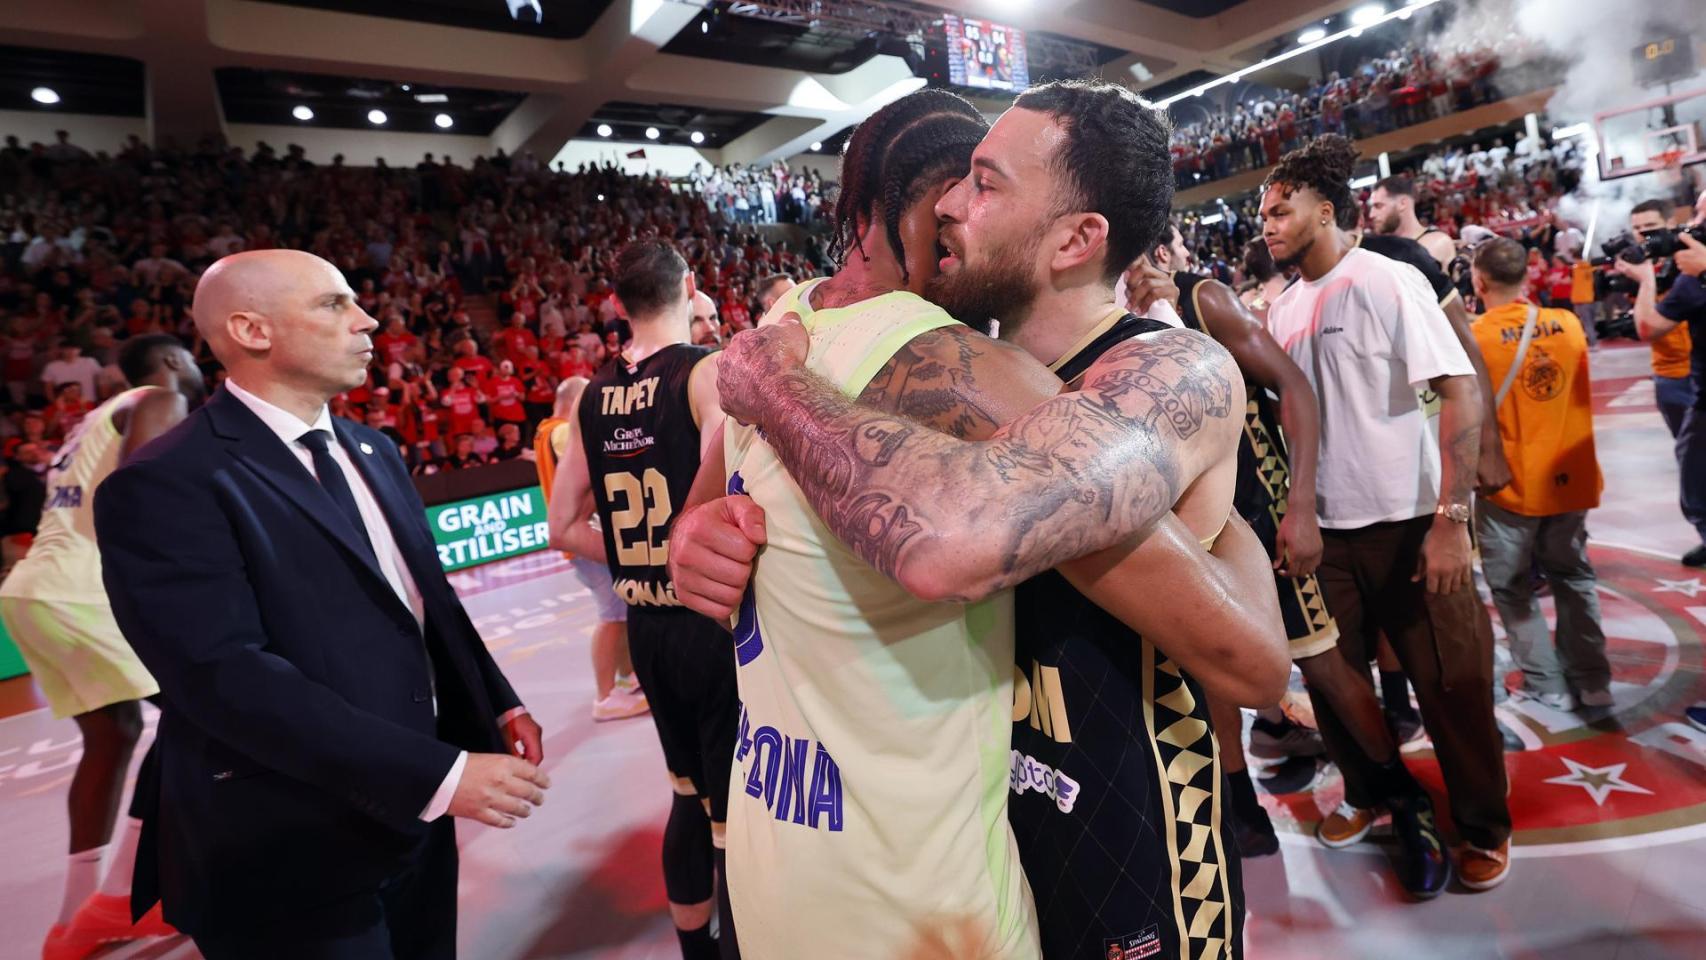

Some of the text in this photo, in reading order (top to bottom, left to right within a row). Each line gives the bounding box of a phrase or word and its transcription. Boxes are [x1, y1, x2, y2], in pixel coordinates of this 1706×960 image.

[437, 493, 532, 532] GRAIN
[474, 520, 507, 537] AND
[604, 467, 672, 566] 22
